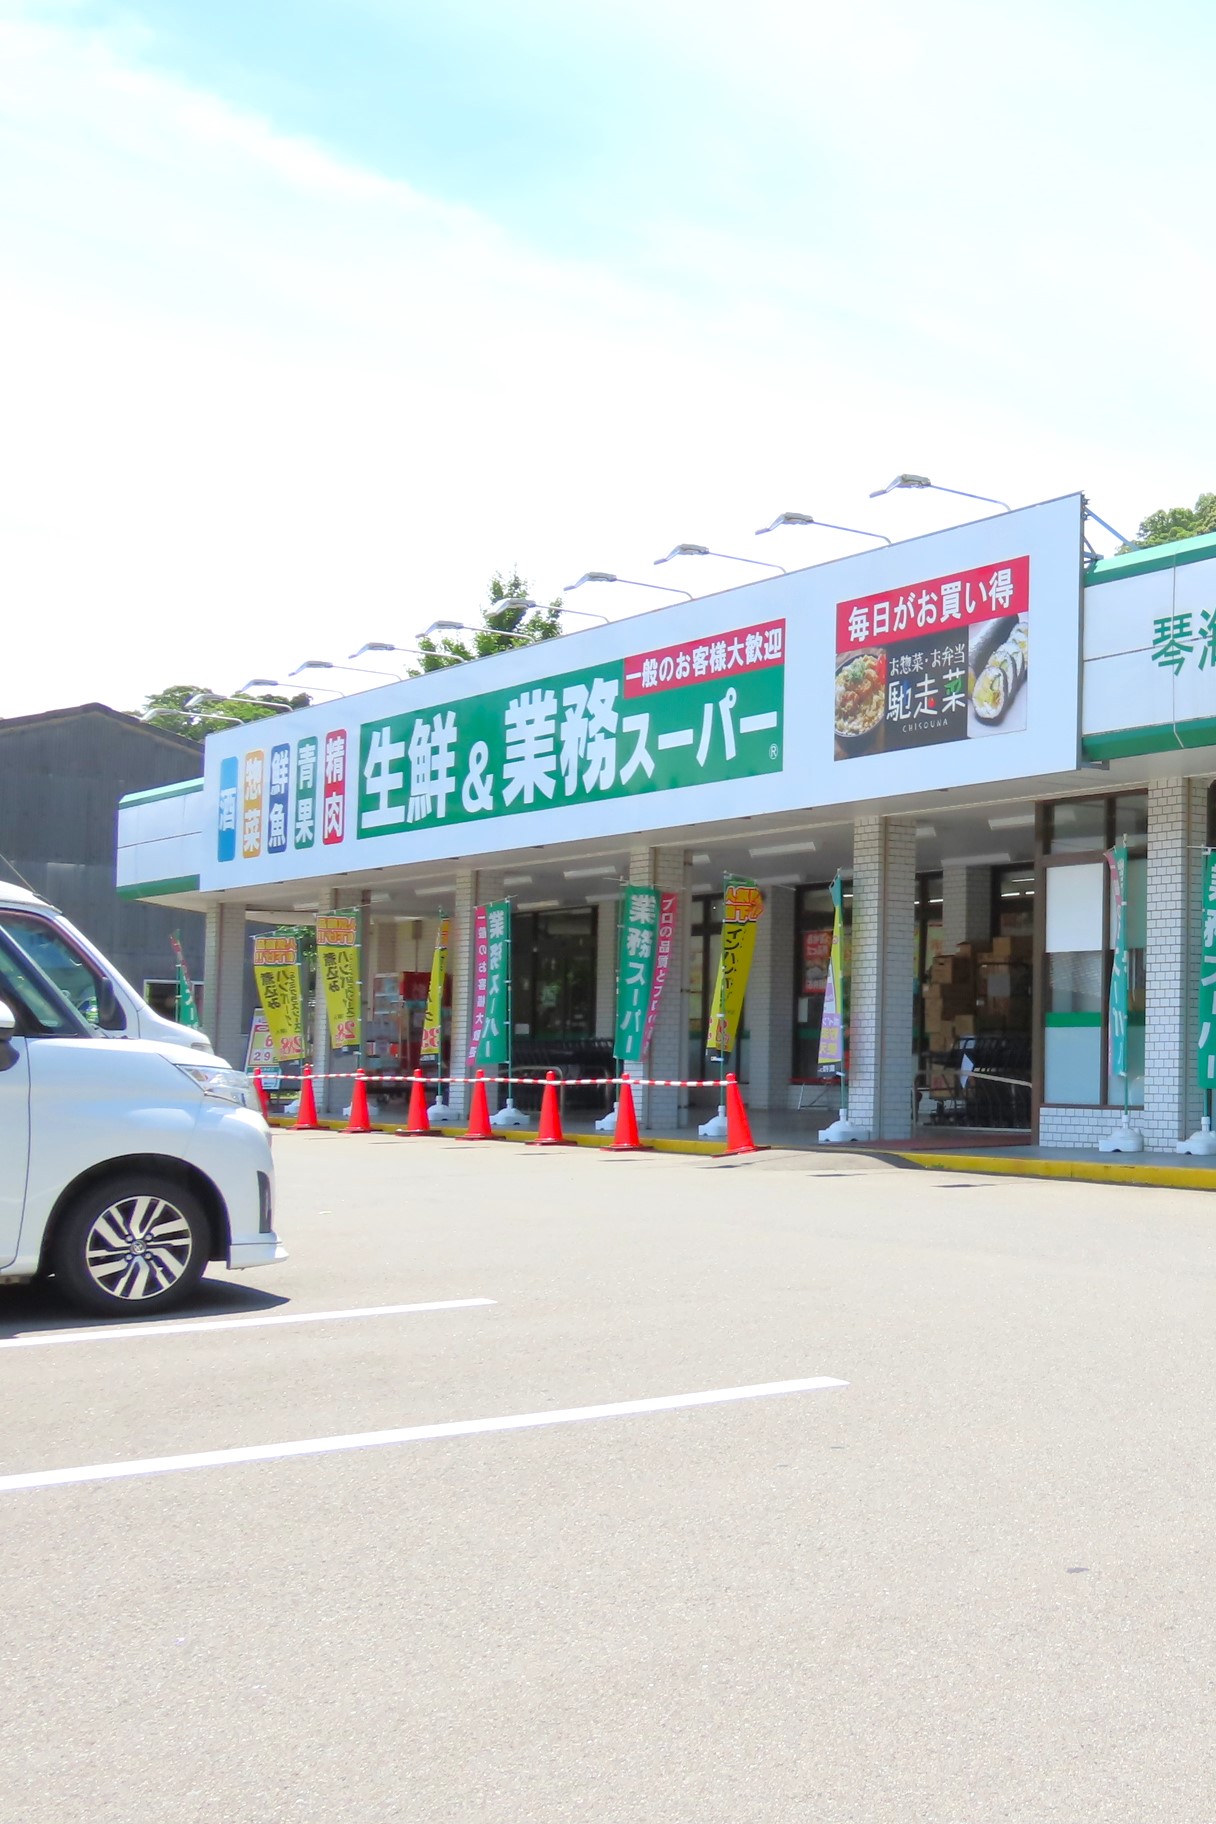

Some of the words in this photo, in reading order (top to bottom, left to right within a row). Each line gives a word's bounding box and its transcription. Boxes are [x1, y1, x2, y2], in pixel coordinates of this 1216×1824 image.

[848, 568, 1013, 642] 毎日がお買い得
[626, 628, 782, 688] 一般のお客様大歓迎
[886, 668, 966, 722] 馳走菜
[902, 718, 949, 733] CHISOUNA
[244, 757, 262, 852] 惣菜
[268, 749, 288, 847] 鮮魚
[295, 743, 316, 843] 青果
[323, 735, 345, 839] 精肉
[620, 894, 656, 1053] 業務スーパー
